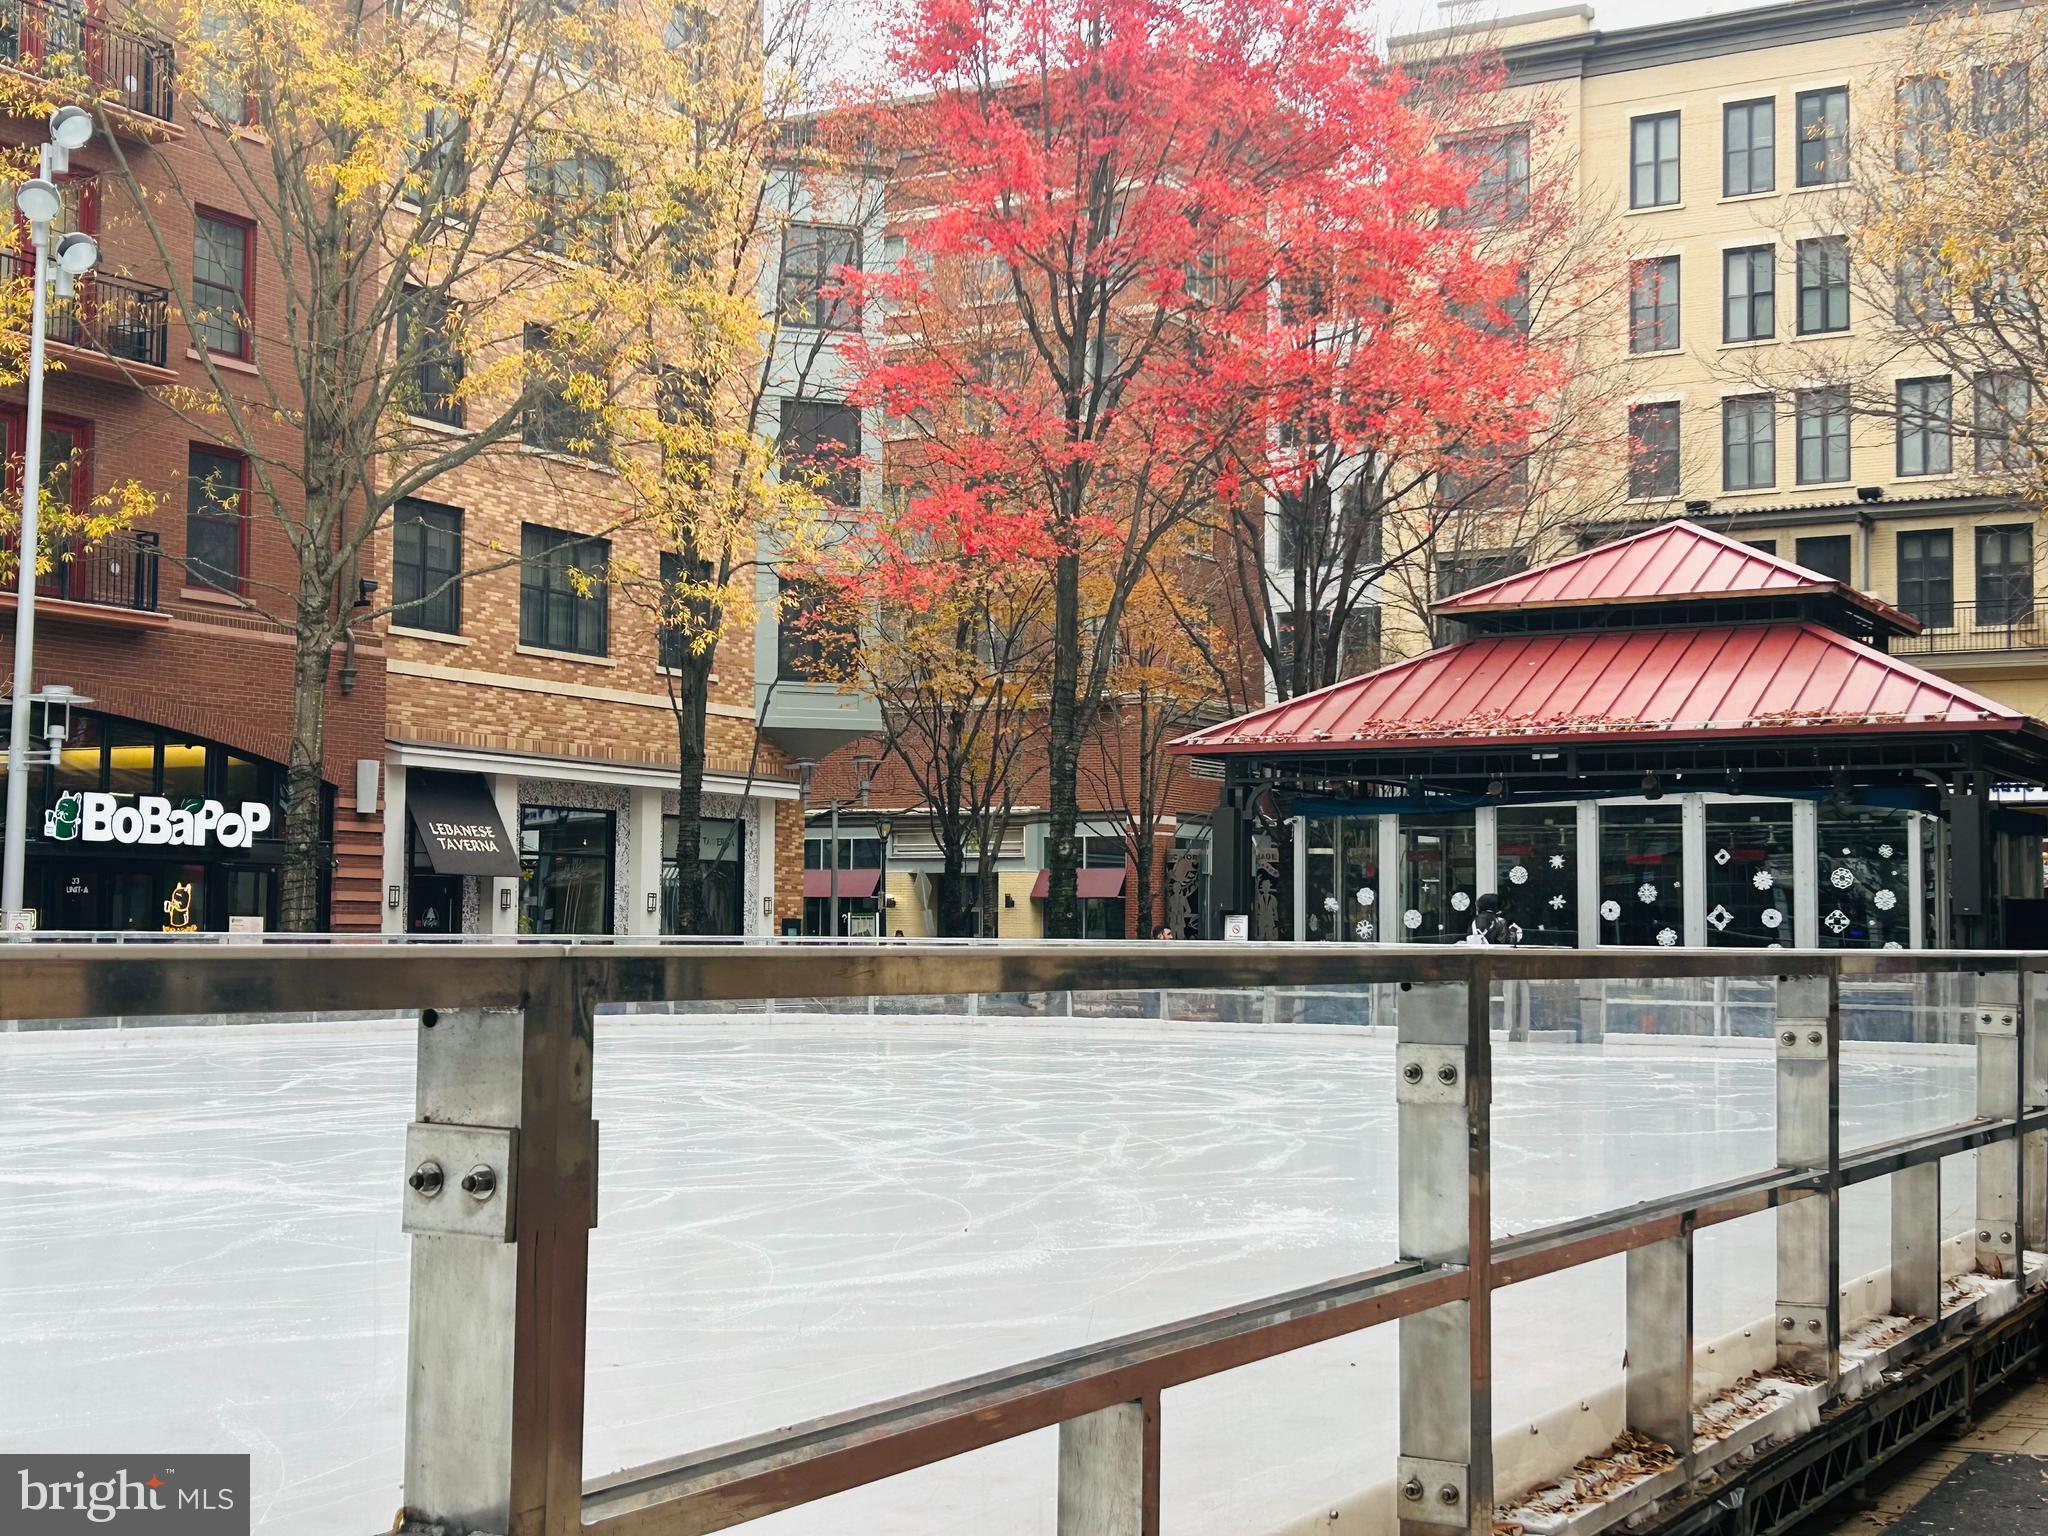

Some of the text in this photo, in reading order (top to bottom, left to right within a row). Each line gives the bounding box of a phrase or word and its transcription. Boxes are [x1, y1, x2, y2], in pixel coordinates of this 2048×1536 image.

[428, 822, 496, 838] LEBANESE
[436, 837, 500, 852] TAVERNA
[71, 877, 80, 885] 33
